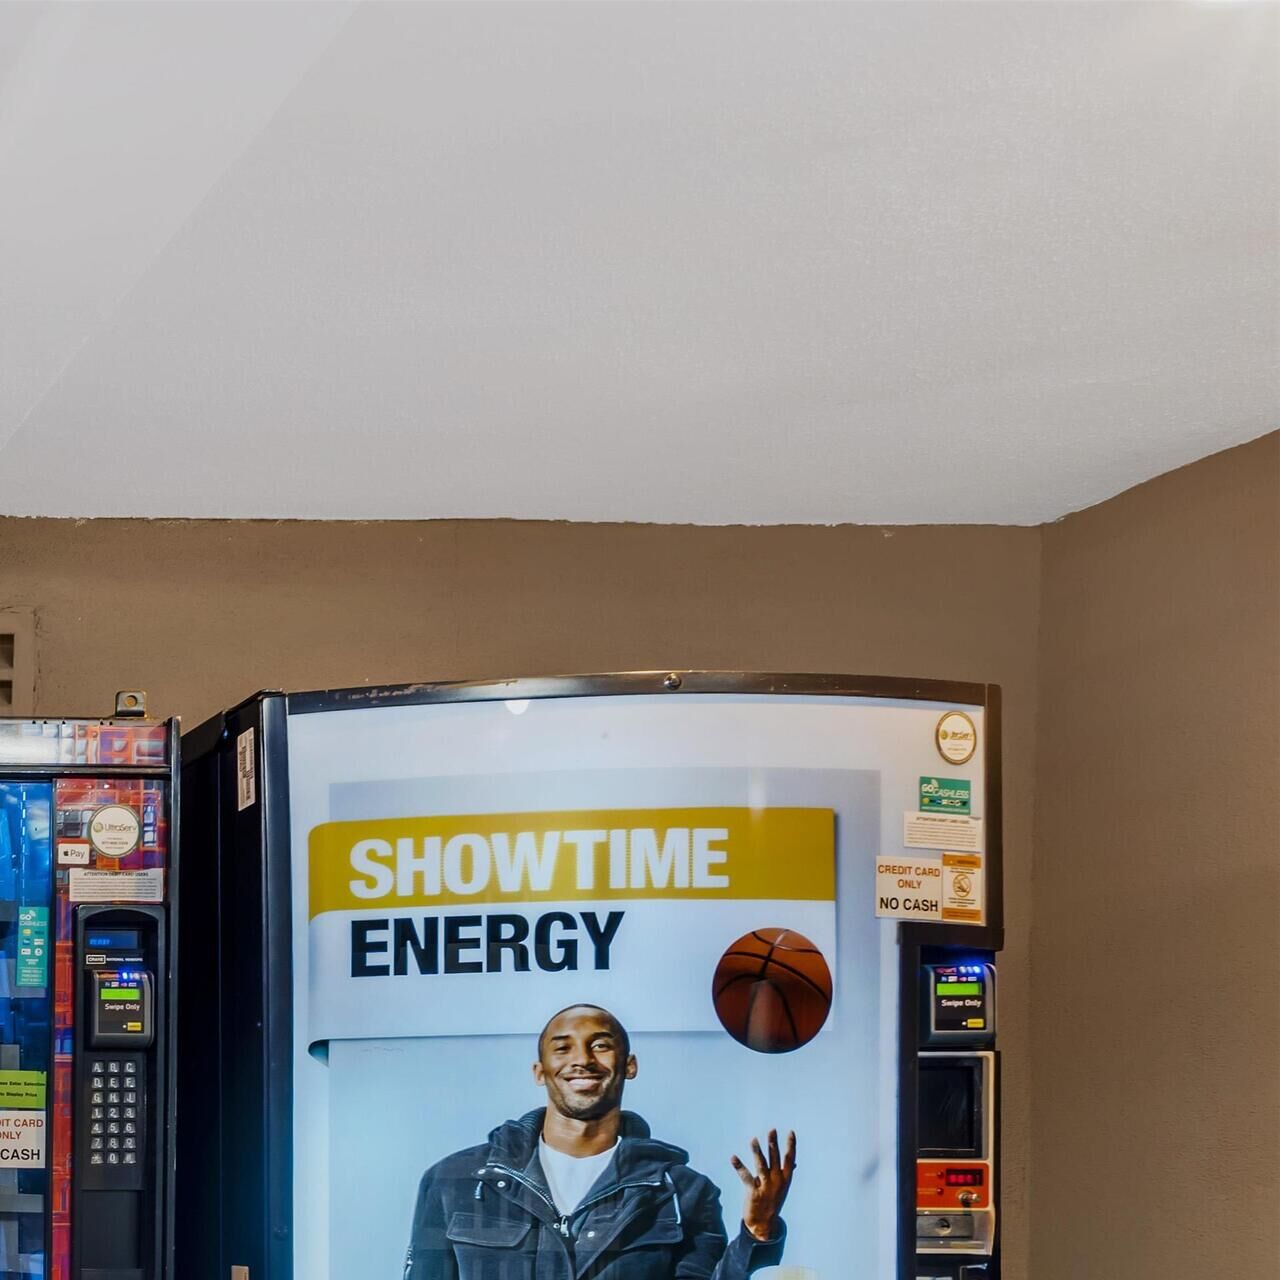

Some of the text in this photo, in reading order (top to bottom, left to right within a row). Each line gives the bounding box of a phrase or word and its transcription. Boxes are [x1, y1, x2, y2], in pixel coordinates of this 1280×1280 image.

[933, 789, 970, 799] CASHLESS
[105, 823, 137, 832] UltraServ
[70, 849, 85, 858] Pay
[349, 827, 729, 899] SHOWTIME
[878, 864, 941, 877] CREDIT CARD
[897, 879, 922, 889] ONLY
[880, 897, 939, 912] NO CASH
[351, 911, 625, 978] ENERGY
[104, 1003, 140, 1011] Swipe Only
[941, 999, 982, 1008] Swipe Only
[14, 1119, 44, 1128] CARD
[0, 1149, 40, 1161] CASH
